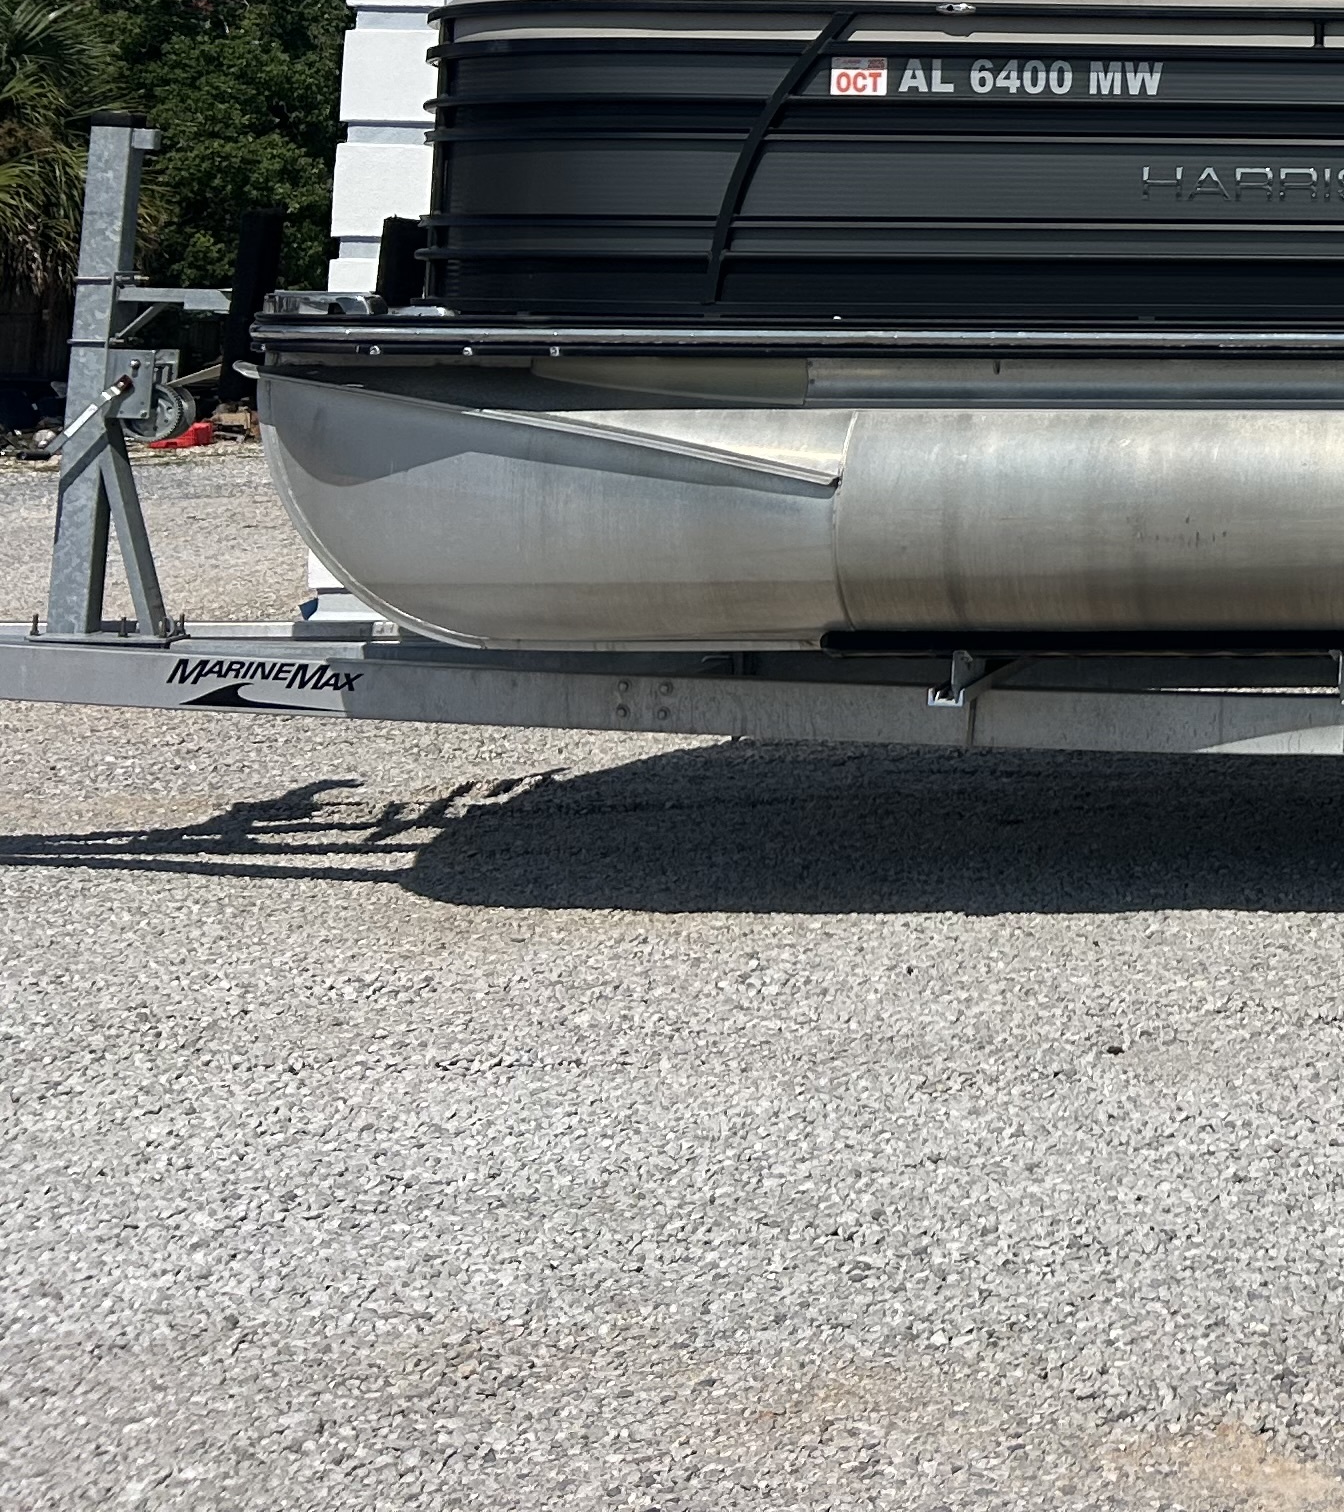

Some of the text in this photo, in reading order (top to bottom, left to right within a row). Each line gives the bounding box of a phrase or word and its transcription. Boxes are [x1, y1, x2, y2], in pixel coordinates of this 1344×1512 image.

[836, 72, 882, 93] OCT
[898, 59, 1163, 95] AL 6400 MW
